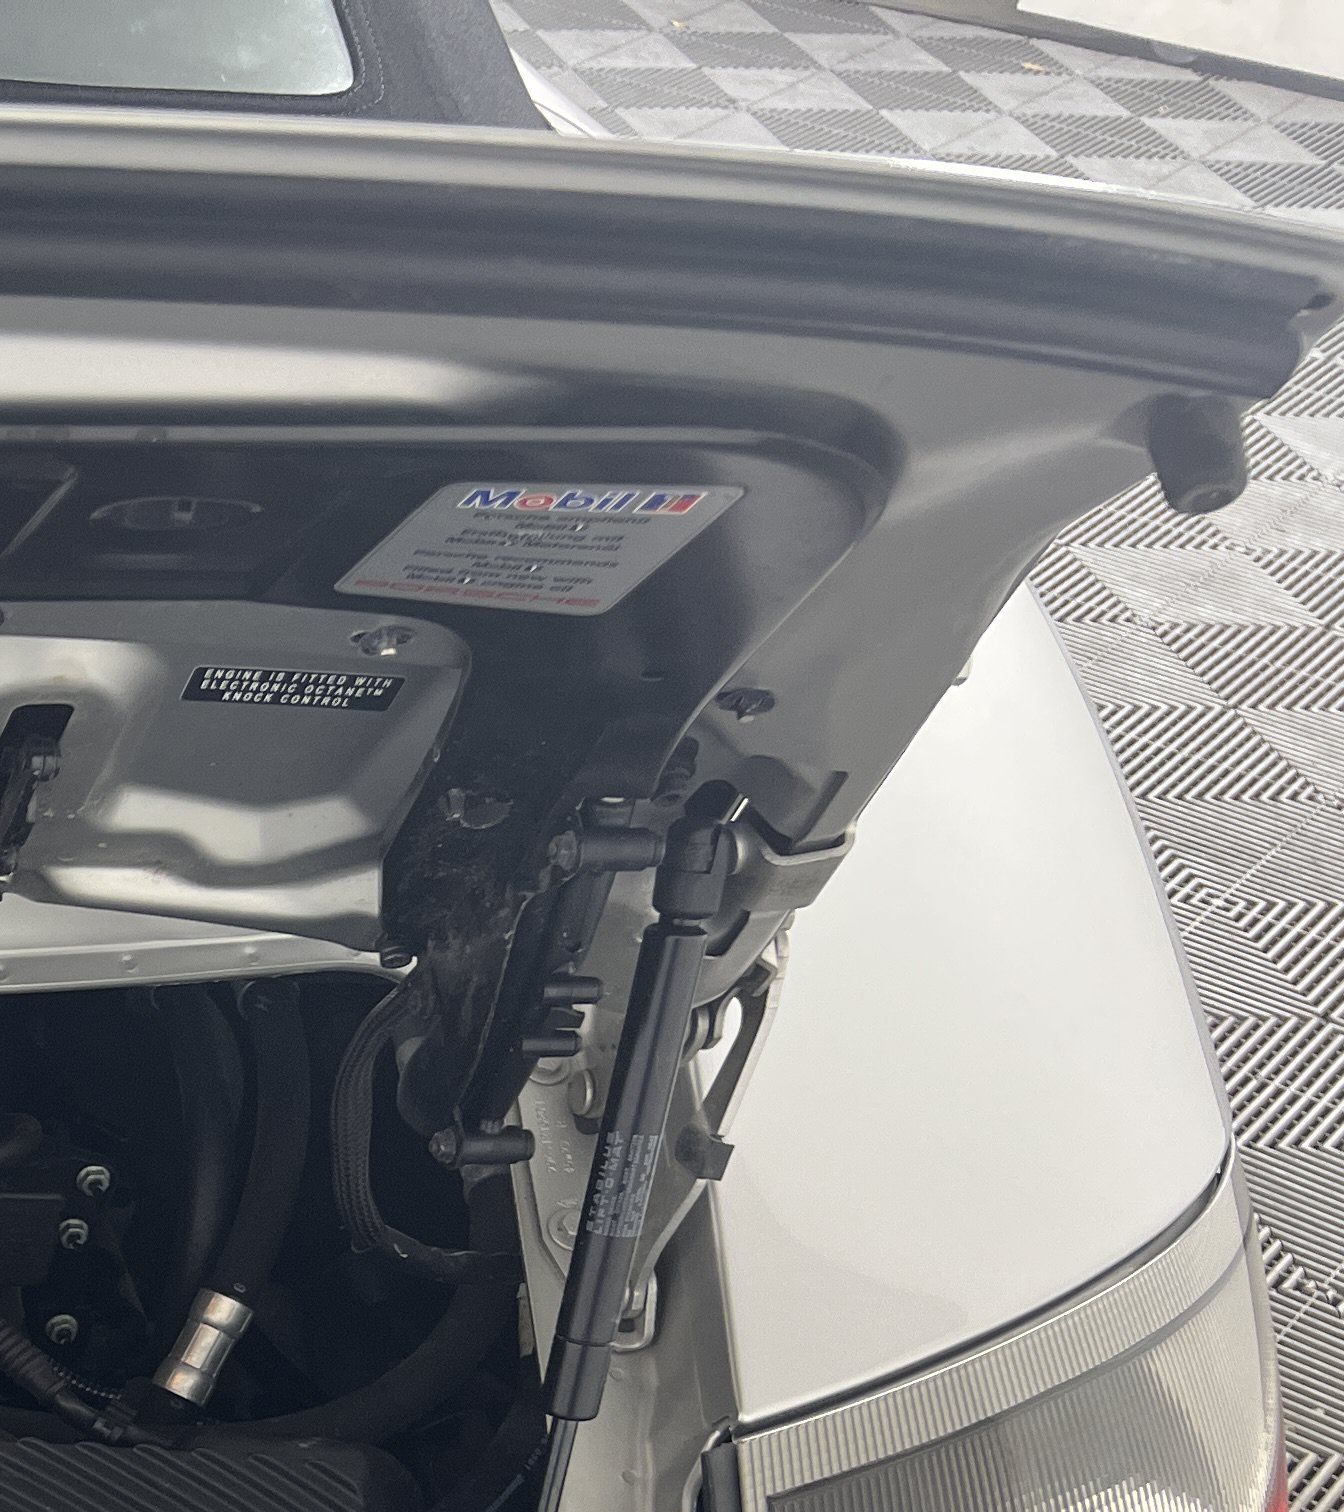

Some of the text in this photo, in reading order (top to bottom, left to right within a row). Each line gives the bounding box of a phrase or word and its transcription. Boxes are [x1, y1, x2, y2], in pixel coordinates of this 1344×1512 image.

[457, 488, 641, 513] Mobil
[199, 678, 298, 694] ELECTRONIC
[203, 668, 394, 688] ENGINE IS FITTED WITH
[220, 691, 351, 708] KNOCK CONTROL
